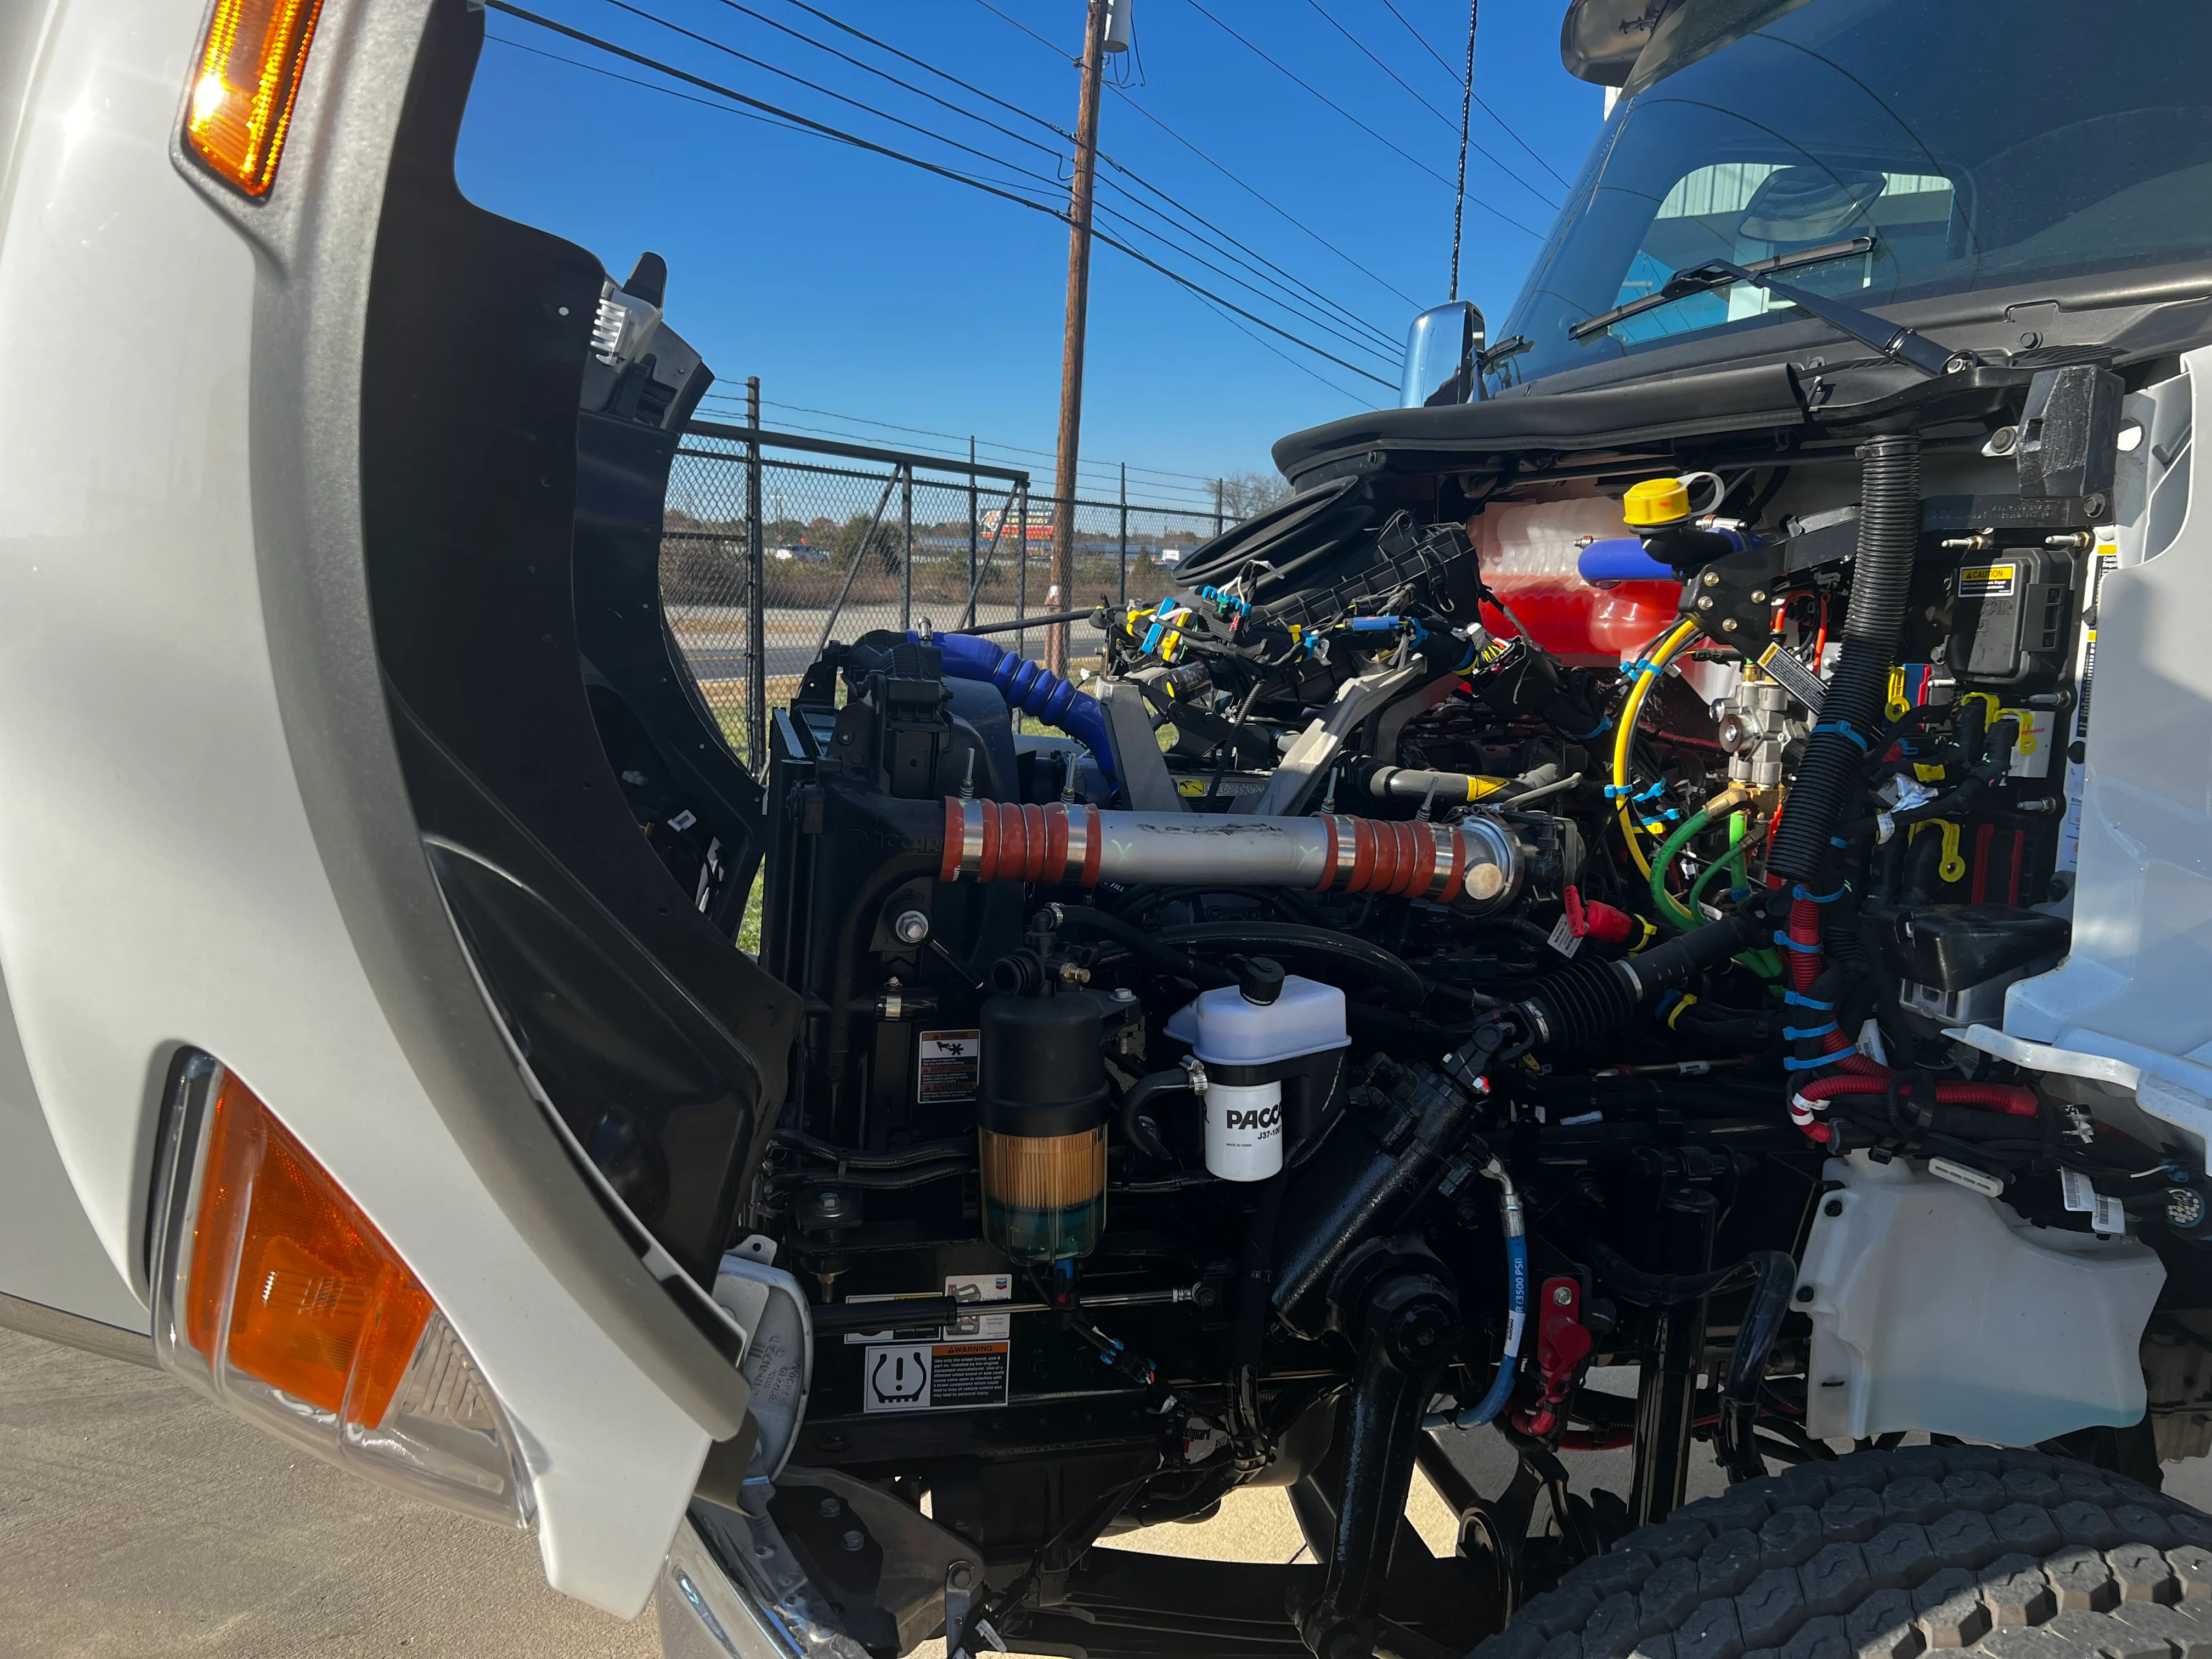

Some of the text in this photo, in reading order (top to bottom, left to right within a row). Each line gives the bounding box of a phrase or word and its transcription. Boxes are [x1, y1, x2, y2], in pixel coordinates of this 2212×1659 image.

[1973, 570, 2004, 578] CAUTION
[1761, 645, 1777, 664] CAUTION
[1110, 883, 1124, 892] FILL
[1514, 1258, 1523, 1275] PSI)
